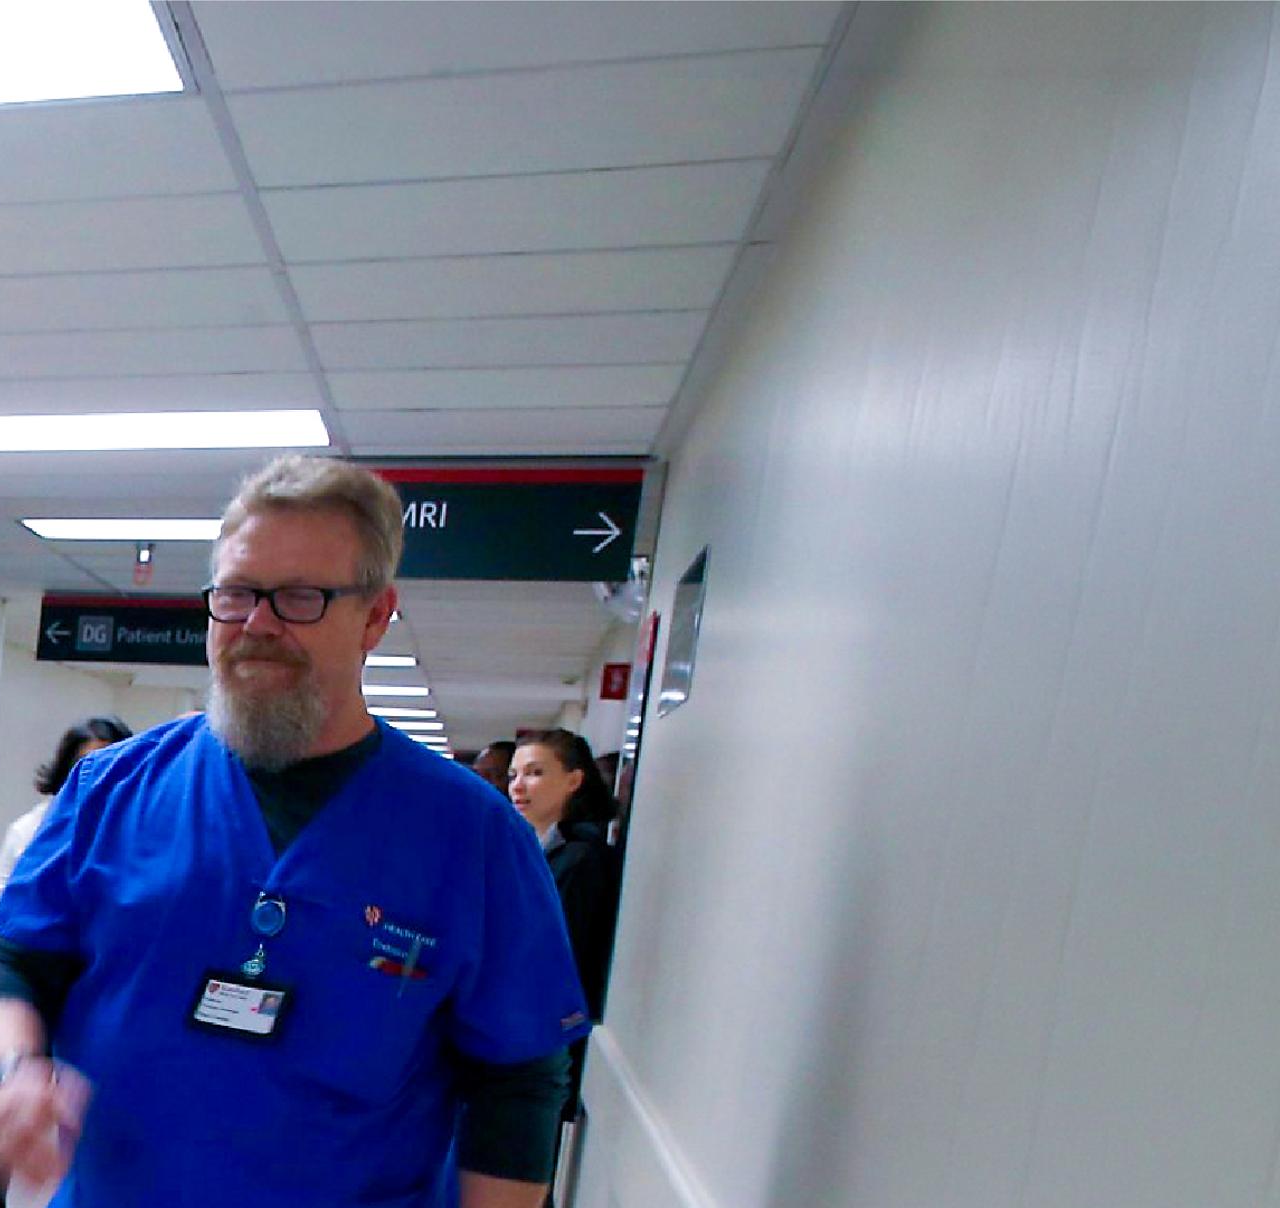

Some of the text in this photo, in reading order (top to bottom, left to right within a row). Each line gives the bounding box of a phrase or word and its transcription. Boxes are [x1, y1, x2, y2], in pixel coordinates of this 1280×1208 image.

[402, 502, 447, 528] MRI
[82, 623, 208, 644] DG Patient Uni
